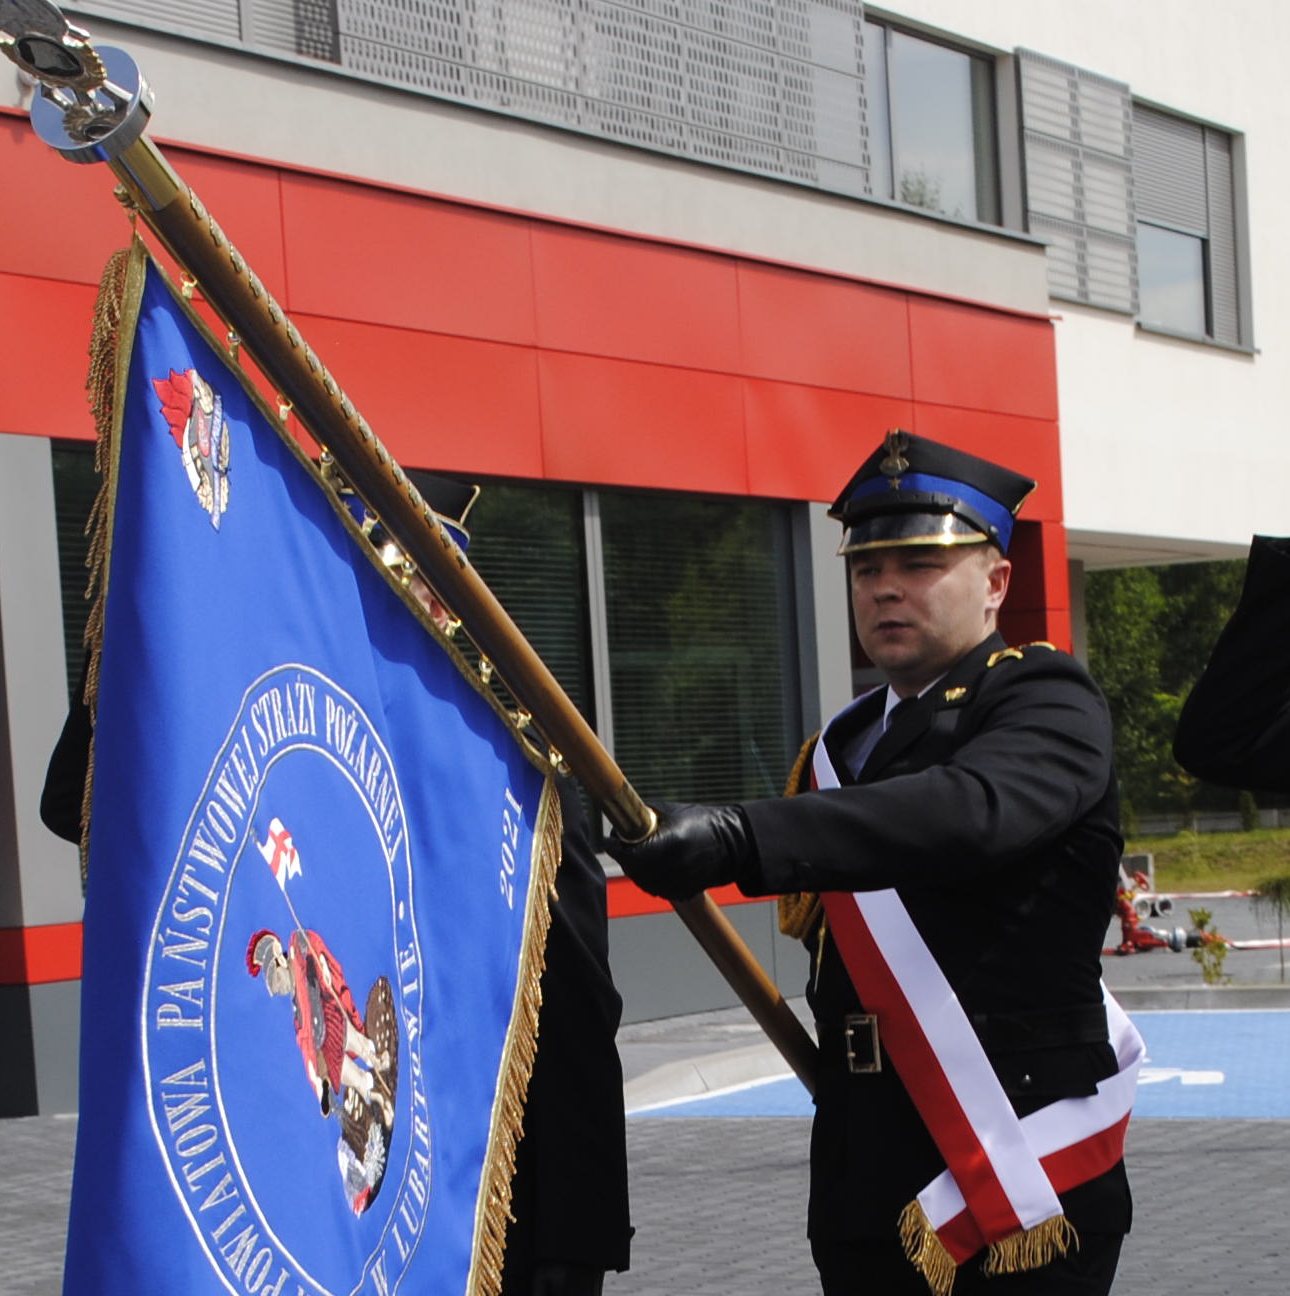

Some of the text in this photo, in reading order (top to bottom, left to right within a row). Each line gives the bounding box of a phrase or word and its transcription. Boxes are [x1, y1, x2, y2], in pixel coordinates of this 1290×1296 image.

[156, 725, 260, 1031] PAŃSTWOWEJ
[251, 674, 317, 756] STRAŻY
[324, 696, 404, 863] POŻARNEJ
[500, 787, 522, 910] 2021
[392, 940, 431, 1260] LUBARTOWIE
